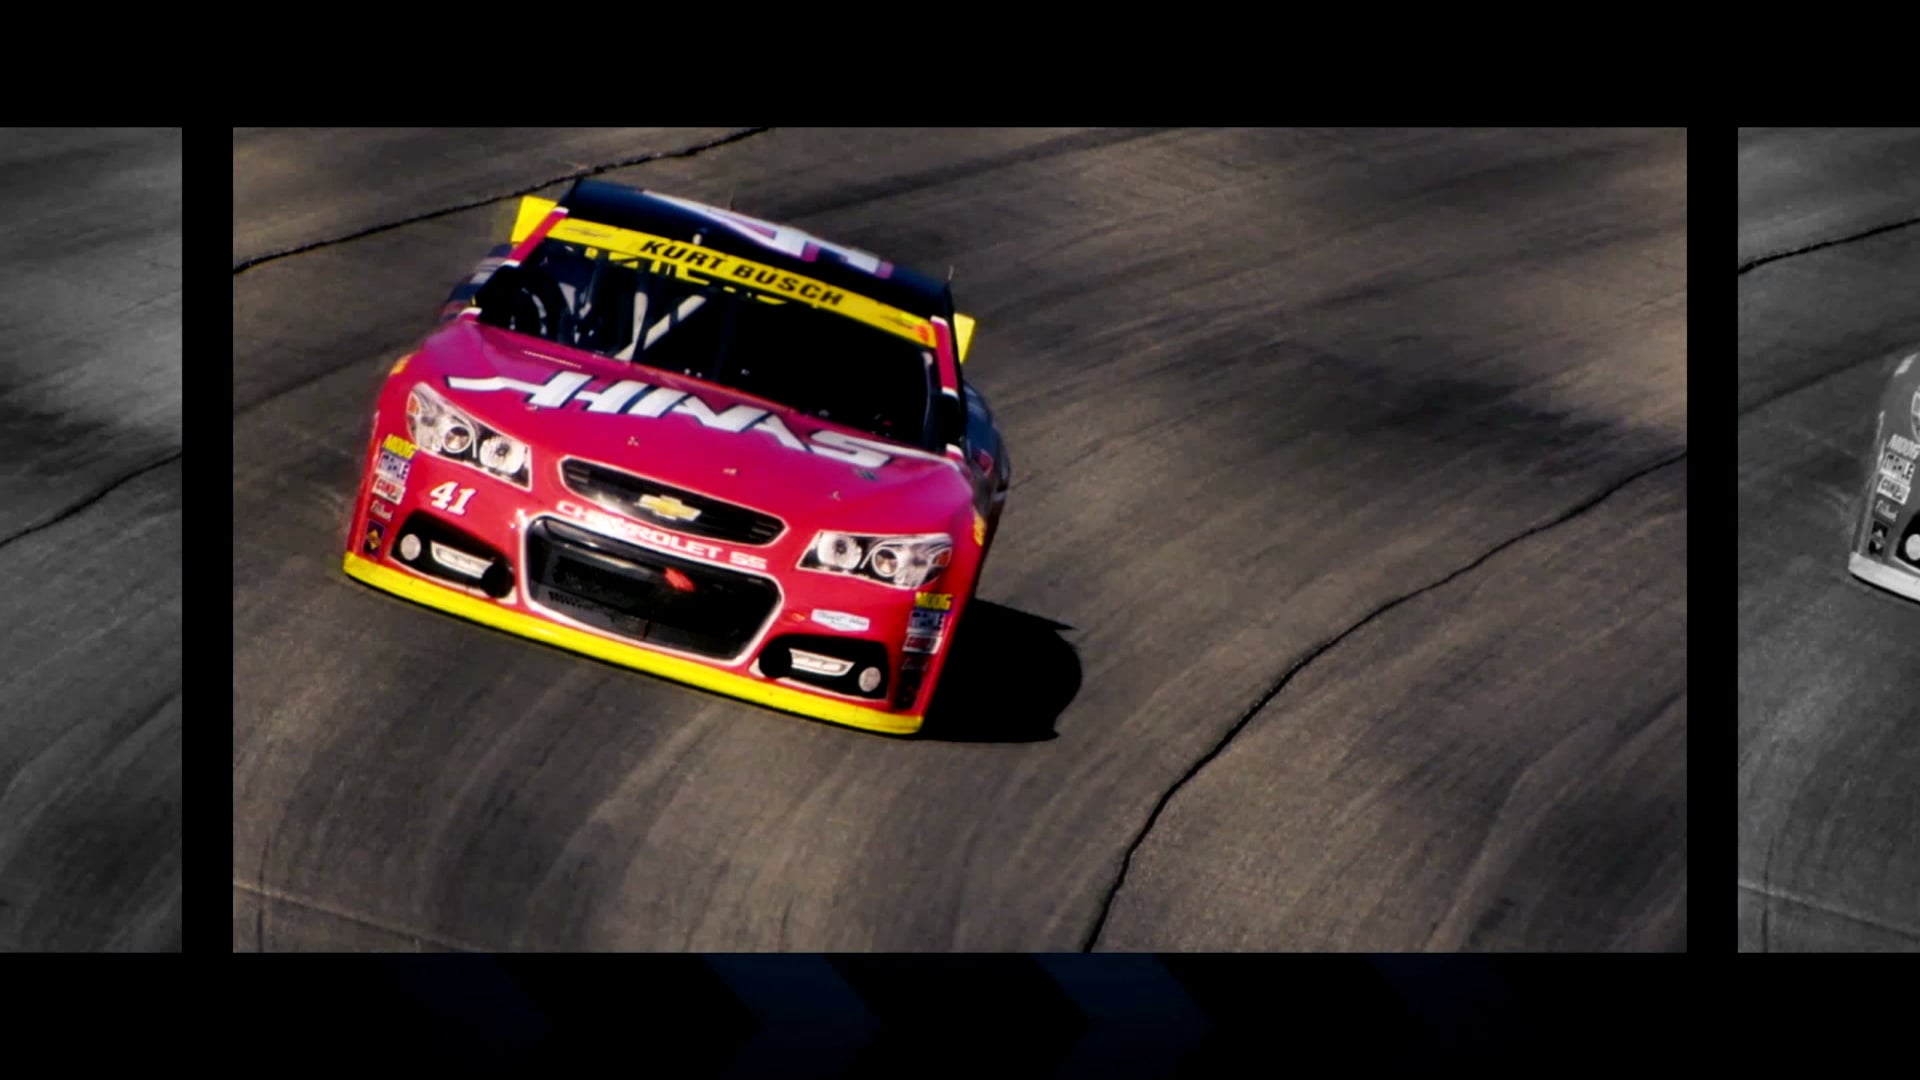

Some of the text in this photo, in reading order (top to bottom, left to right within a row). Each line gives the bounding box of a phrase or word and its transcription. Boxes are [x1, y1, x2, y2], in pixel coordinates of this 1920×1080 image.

[639, 239, 846, 307] KURT BUSCH
[430, 481, 476, 515] 41
[557, 501, 768, 570] CHEVROLET SS
